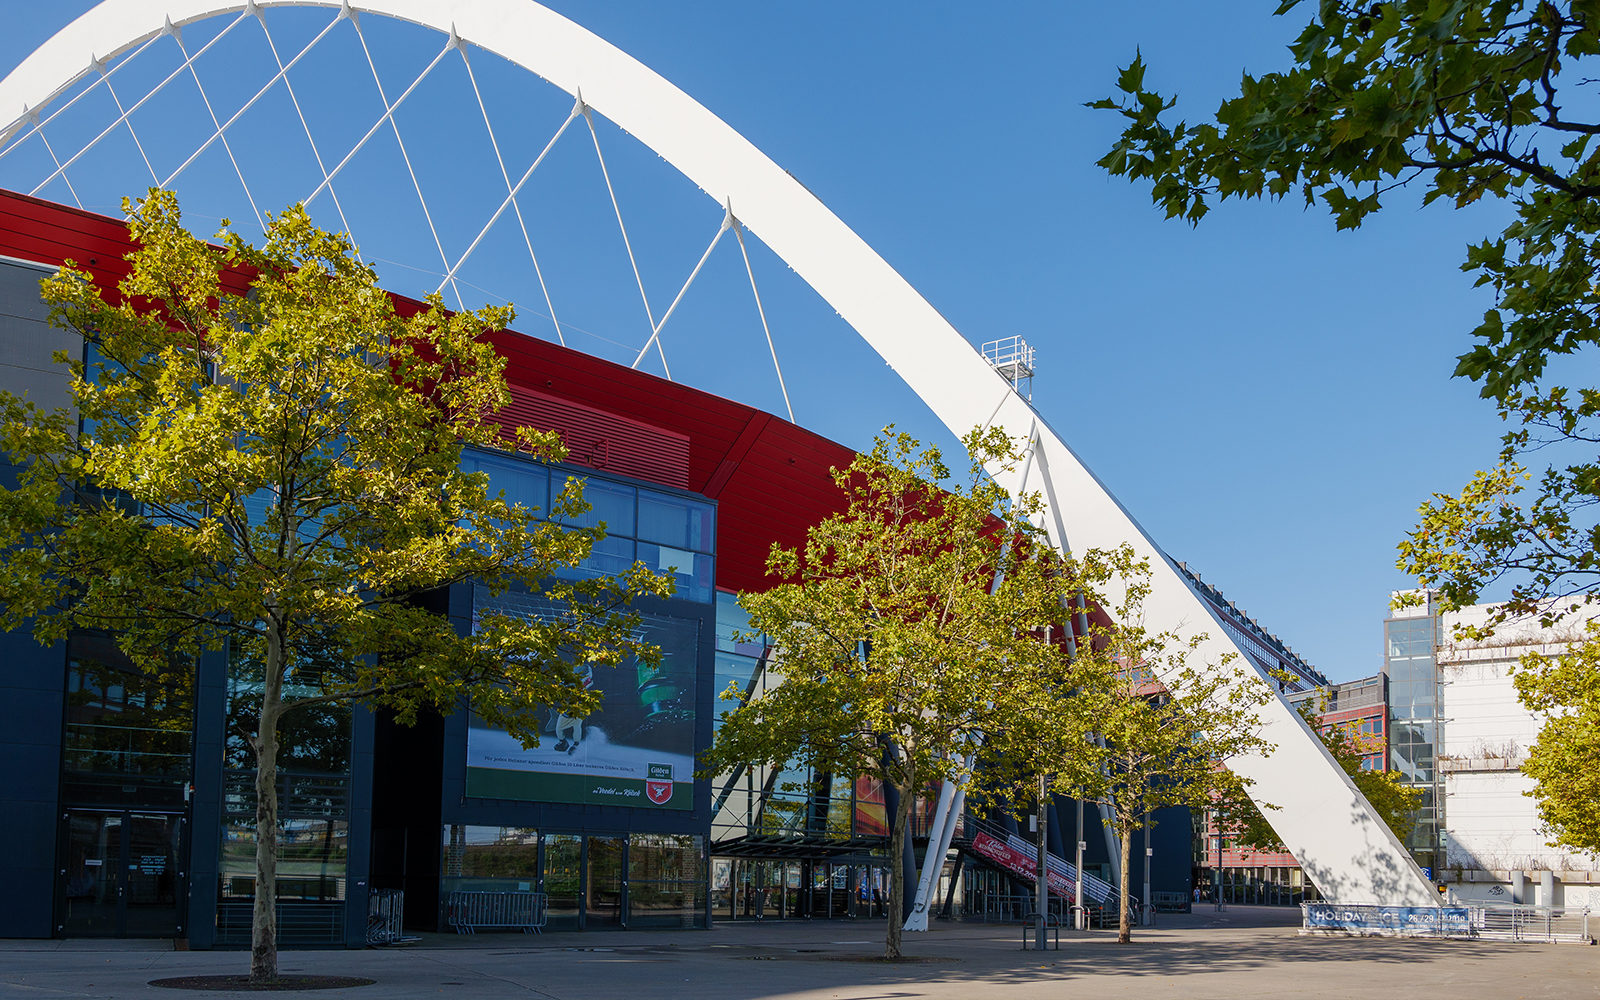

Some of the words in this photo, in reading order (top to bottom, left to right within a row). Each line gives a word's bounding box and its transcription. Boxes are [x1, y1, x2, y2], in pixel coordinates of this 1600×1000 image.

[650, 766, 670, 775] Gilden
[1315, 911, 1367, 922] HOLIDAY
[1378, 912, 1399, 923] ICE
